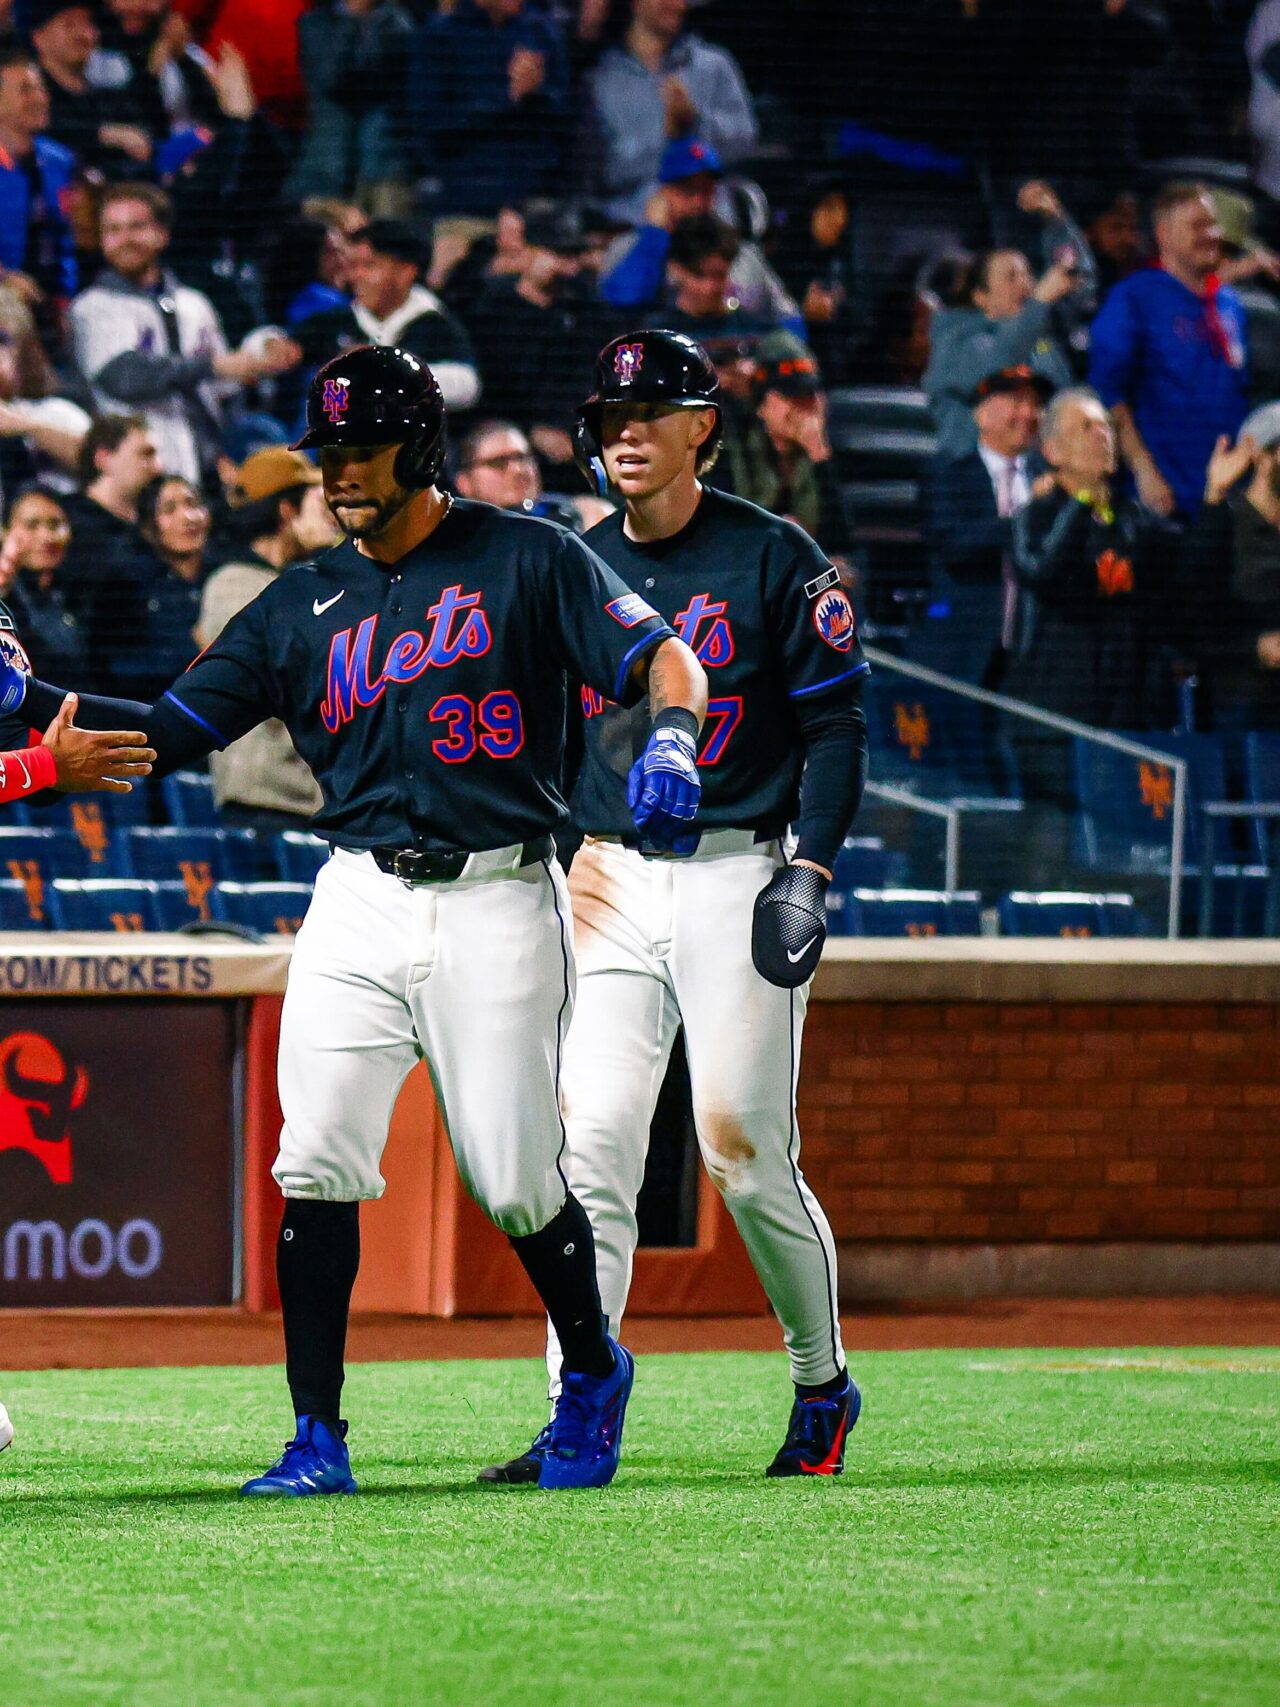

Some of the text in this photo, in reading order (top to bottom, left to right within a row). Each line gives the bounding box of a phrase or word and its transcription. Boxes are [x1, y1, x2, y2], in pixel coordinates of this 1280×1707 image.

[319, 583, 493, 734] Mets
[429, 689, 525, 764] 39
[696, 696, 744, 767] 7
